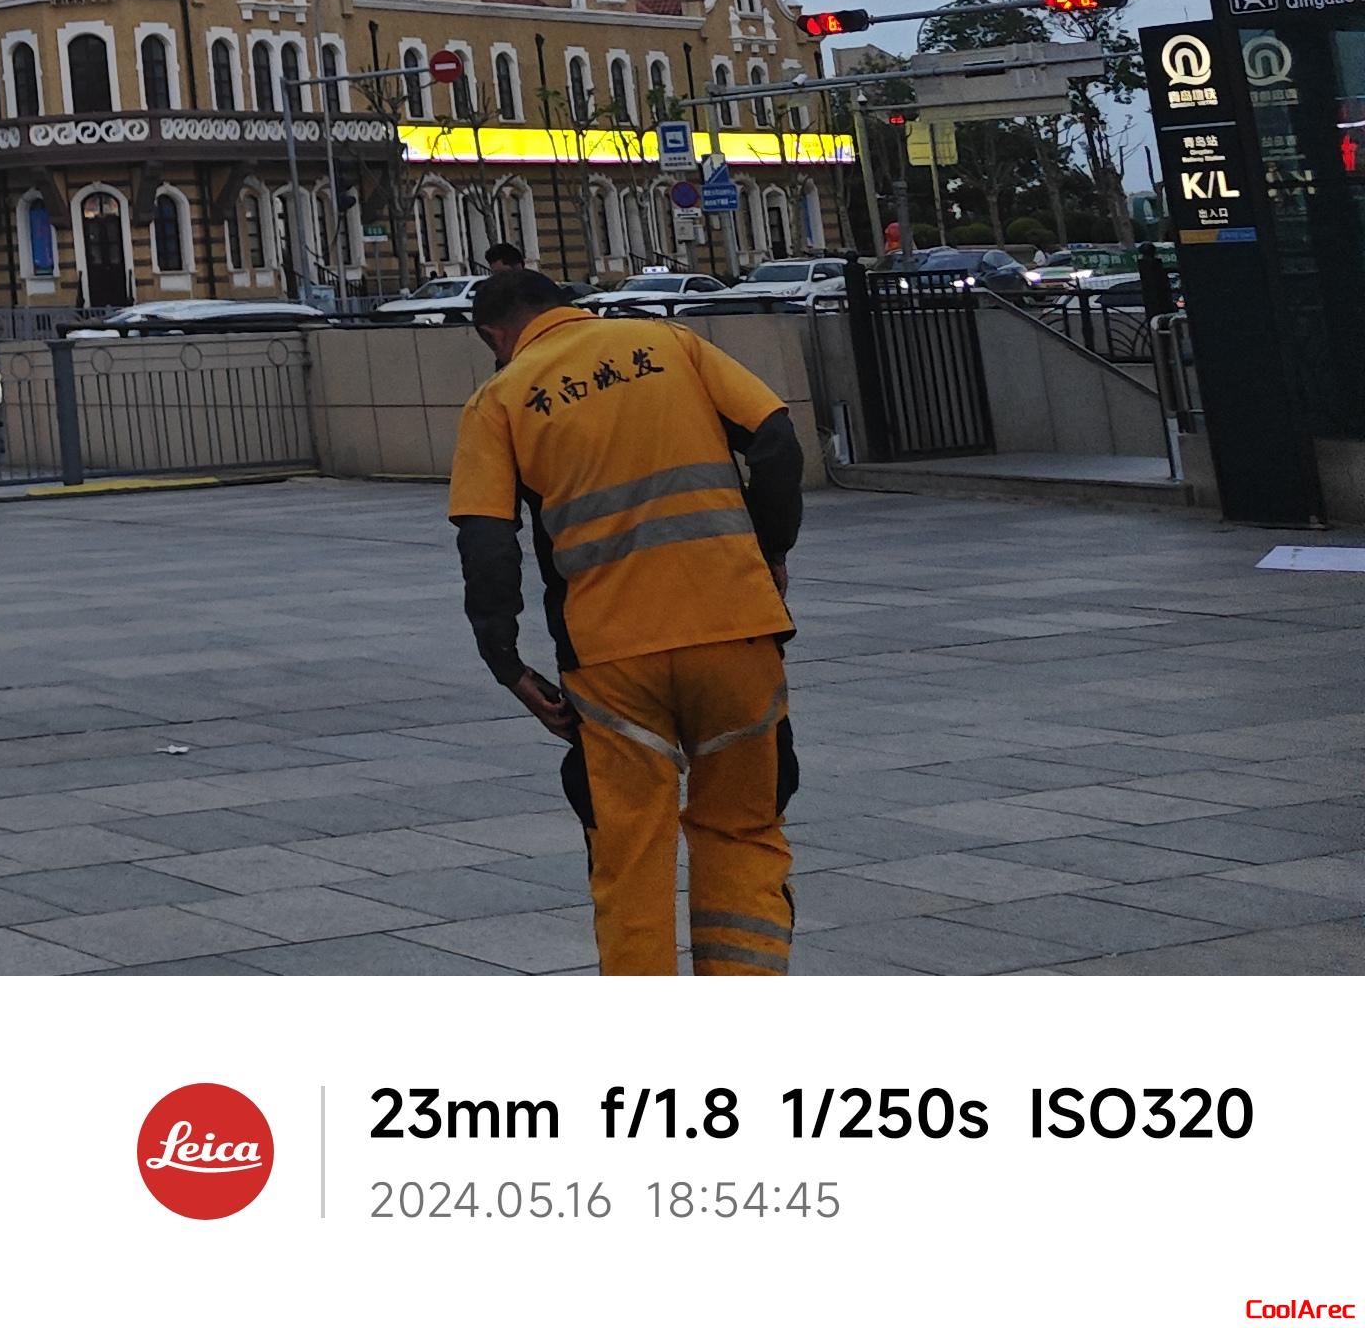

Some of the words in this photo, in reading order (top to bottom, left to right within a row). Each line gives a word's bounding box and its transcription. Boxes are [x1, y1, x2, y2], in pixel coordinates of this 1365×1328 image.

[1183, 134, 1219, 149] 青岛站
[1181, 170, 1241, 200] K/L
[1198, 207, 1229, 219] 出入口
[525, 346, 665, 417] 市南城发
